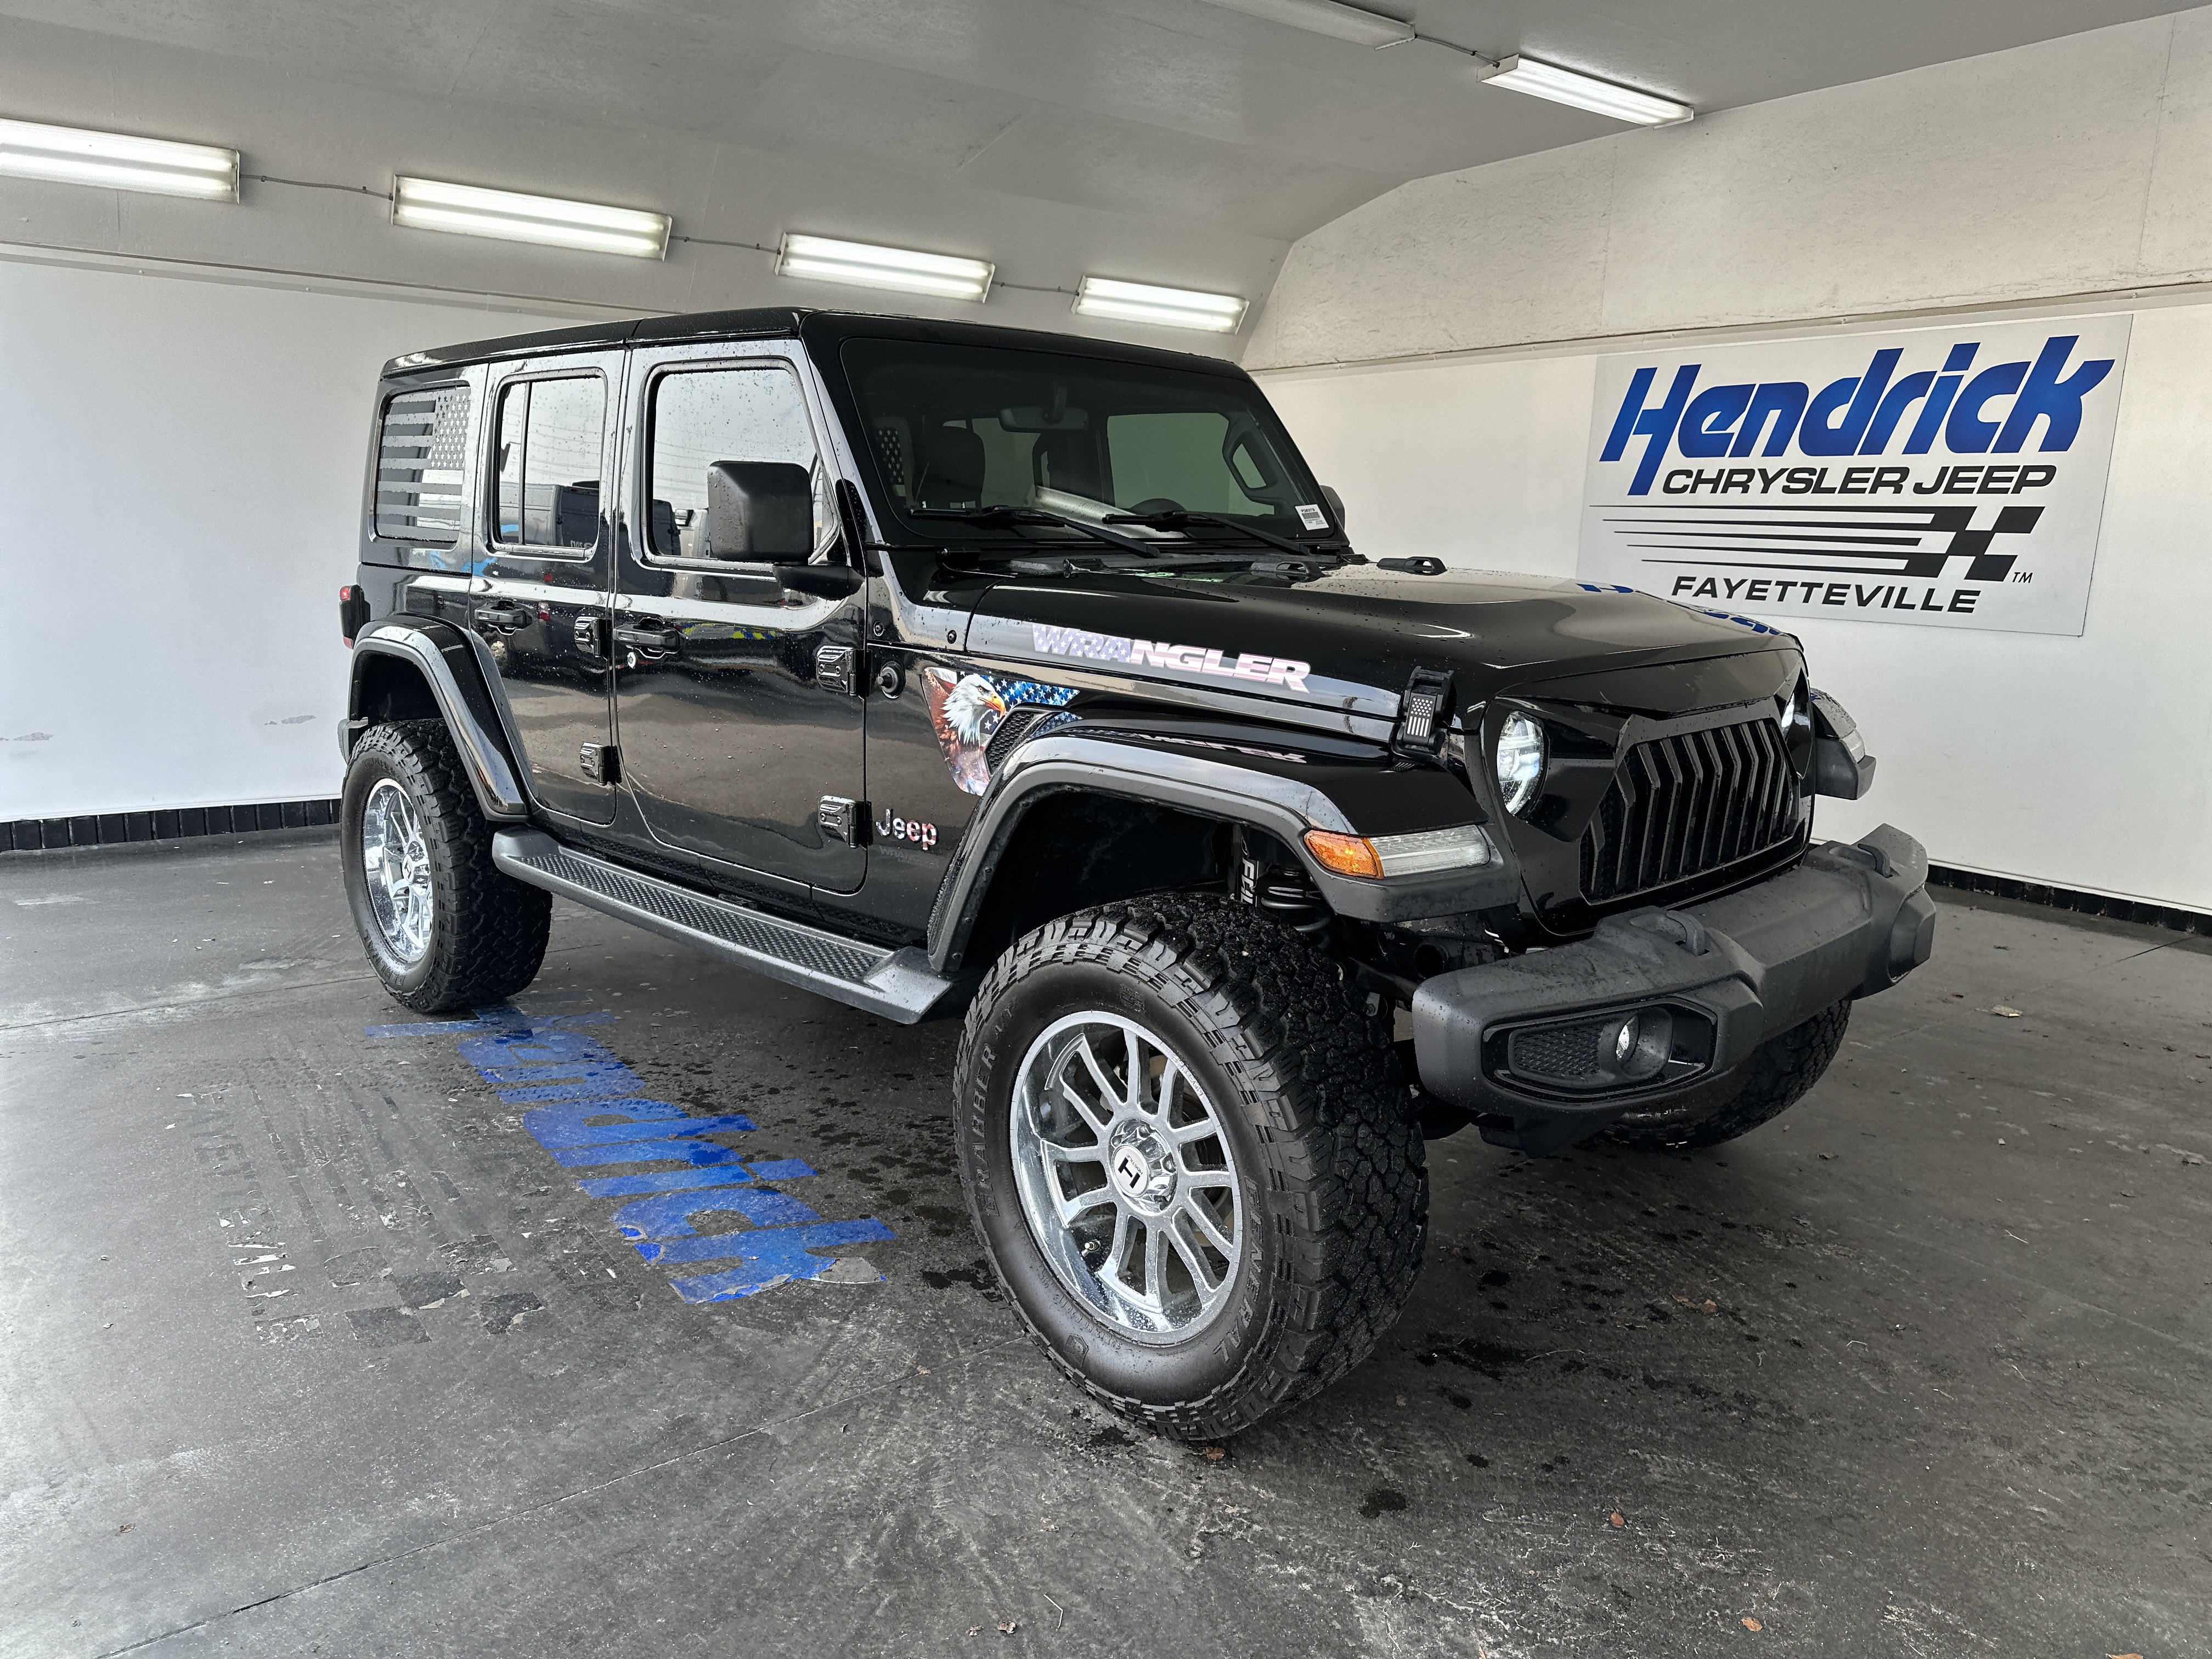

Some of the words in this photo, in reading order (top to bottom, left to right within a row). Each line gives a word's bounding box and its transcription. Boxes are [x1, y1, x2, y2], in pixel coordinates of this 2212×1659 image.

[1599, 335, 2115, 496] Hendrick
[1662, 466, 1910, 495] CHRYSLER
[1913, 465, 2057, 495] JEEP
[1672, 576, 1980, 613] FAYETTEVILLE
[2013, 572, 2033, 584] TM
[1032, 623, 1311, 693] WRANGLER
[876, 808, 938, 850] Jeep
[972, 1043, 1000, 1217] GRABBER
